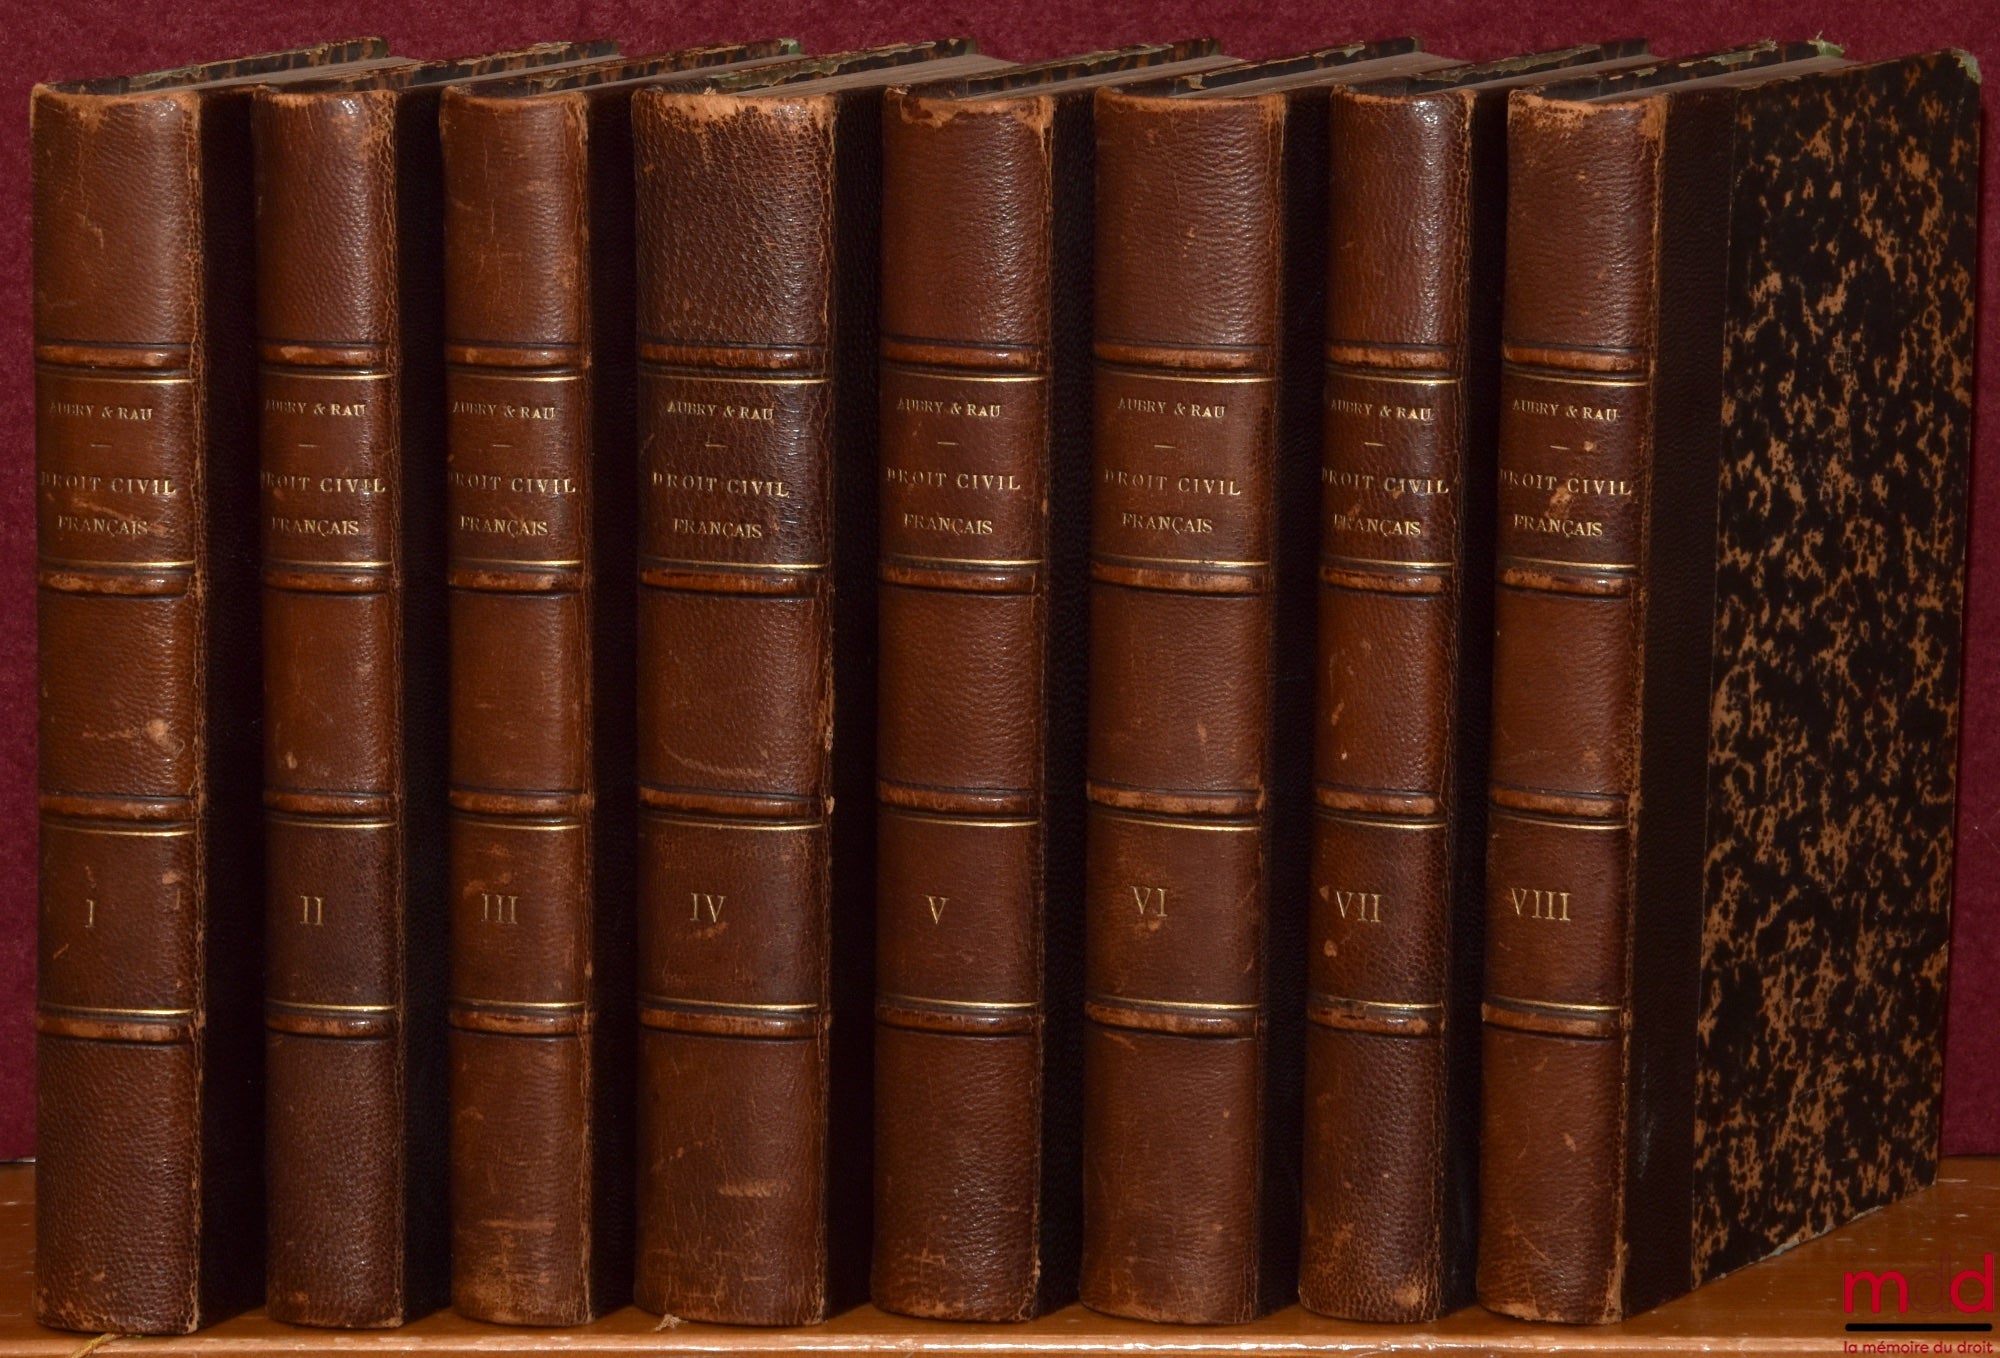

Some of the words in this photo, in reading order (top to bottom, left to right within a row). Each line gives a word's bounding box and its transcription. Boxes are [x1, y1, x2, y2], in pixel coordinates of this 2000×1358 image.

[102, 406, 113, 418] &
[118, 407, 152, 420] RAU
[314, 403, 326, 415] &
[331, 403, 366, 416] RAU
[504, 405, 515, 418] &
[521, 406, 555, 419] RAU
[668, 401, 717, 417] AUBRY
[723, 405, 734, 418] &
[740, 406, 774, 420] RAU
[951, 402, 962, 415] &
[967, 403, 1000, 417] RAU
[1174, 402, 1186, 416] &
[1191, 404, 1225, 418] RAU
[1380, 405, 1392, 418] &
[1398, 406, 1432, 420] RAU
[1566, 405, 1578, 418] &
[1583, 407, 1618, 422] RAU
[112, 478, 176, 496] CIVIL
[320, 478, 386, 493] CIVIL
[512, 478, 576, 493] CIVIL
[653, 472, 718, 492] DROIT
[727, 479, 789, 498] CIVIL
[957, 474, 1020, 490] CIVIL
[1105, 469, 1168, 490] DROIT
[1179, 478, 1241, 496] CIVIL
[1384, 478, 1448, 494] CIVIL
[1568, 478, 1632, 496] CIVIL
[461, 515, 548, 537] FRANÇAIS
[1123, 512, 1213, 535] FRANÇAIS
[1514, 514, 1602, 538] FRANÇAIS
[300, 895, 324, 925] II
[481, 893, 518, 925] III
[690, 892, 726, 923] IV
[926, 895, 950, 925] V
[1131, 885, 1168, 917] VI
[1335, 890, 1382, 924] VII
[1511, 886, 1571, 922] VIII
[85, 899, 96, 928] I
